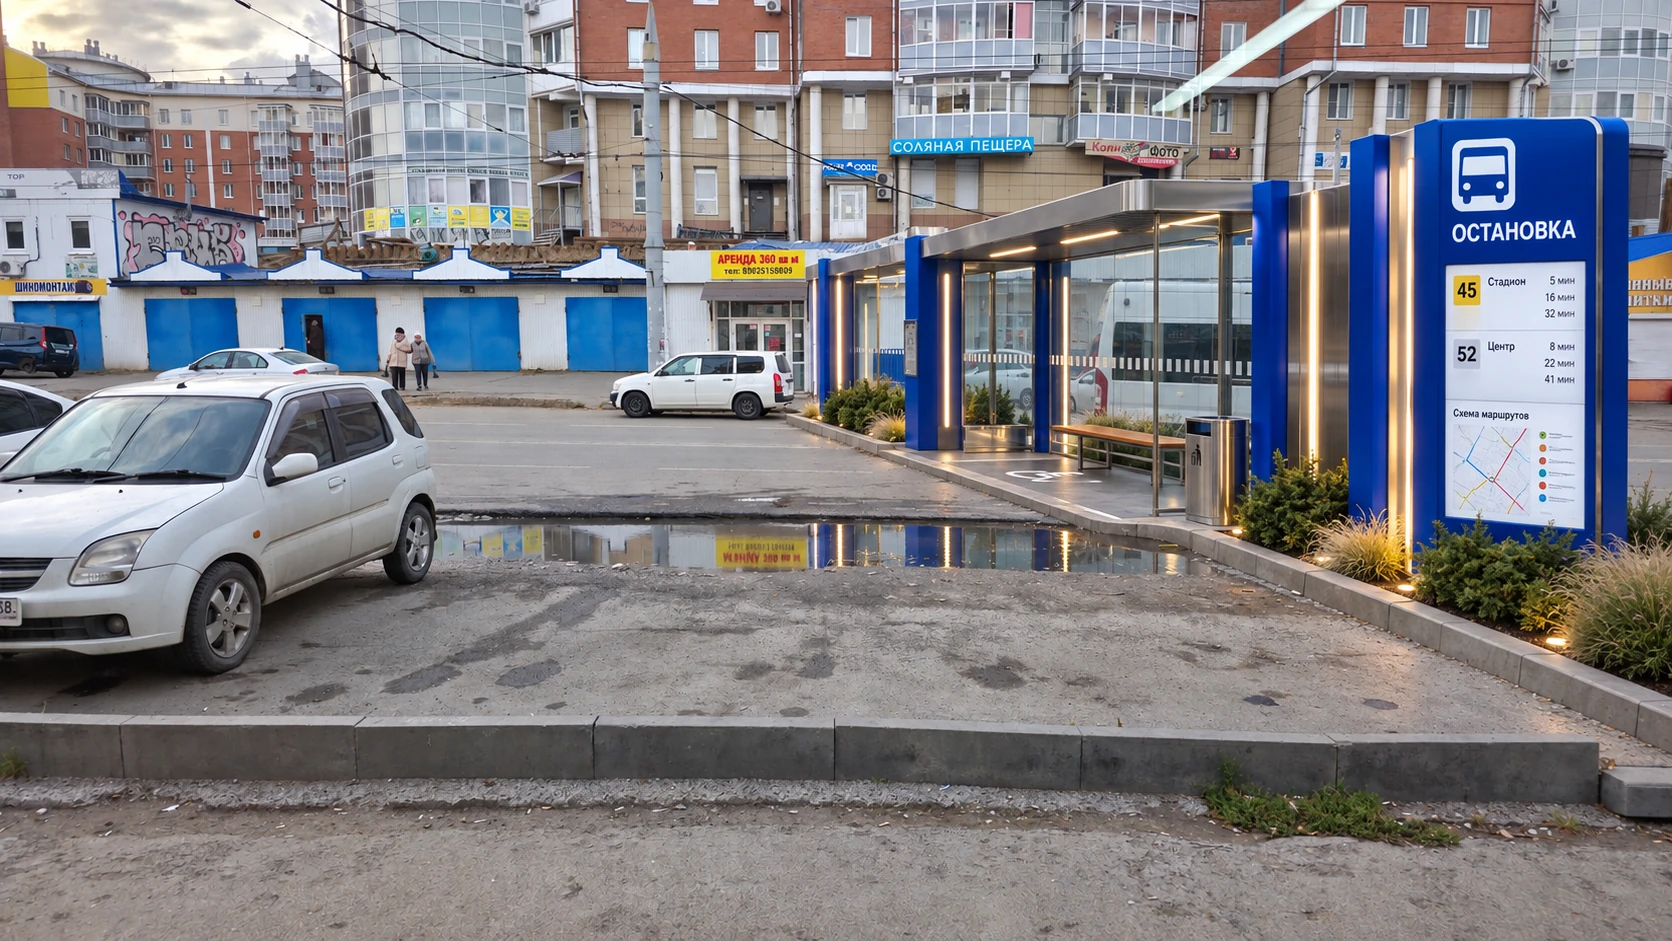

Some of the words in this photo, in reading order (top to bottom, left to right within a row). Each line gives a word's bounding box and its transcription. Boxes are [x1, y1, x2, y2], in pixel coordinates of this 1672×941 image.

[892, 140, 964, 153] СОЛЯНАЯ
[970, 138, 1033, 153] ПЕЩЕРА
[1452, 219, 1577, 243] ОСТАНОВКА
[718, 253, 757, 266] АРЕНДА
[759, 253, 776, 264] 360
[1487, 276, 1527, 287] Стадион
[1549, 276, 1556, 285] 5
[1557, 277, 1576, 286] мин
[14, 281, 76, 293] ШИНОМОНТАЖ
[1457, 282, 1477, 298] 45
[1545, 293, 1556, 302] 16
[1557, 294, 1576, 302] мин
[1544, 309, 1556, 318] 32
[1557, 310, 1576, 318] мин
[1487, 341, 1516, 352] Центр
[1549, 342, 1556, 351] 8
[1557, 343, 1576, 351] мин
[1457, 345, 1477, 362] 52
[1544, 358, 1556, 368] 22
[1557, 360, 1576, 368] мин
[1544, 375, 1555, 384] 41
[1557, 376, 1576, 384] мин
[1453, 408, 1480, 418] Схема
[1481, 411, 1530, 422] маршрутов
